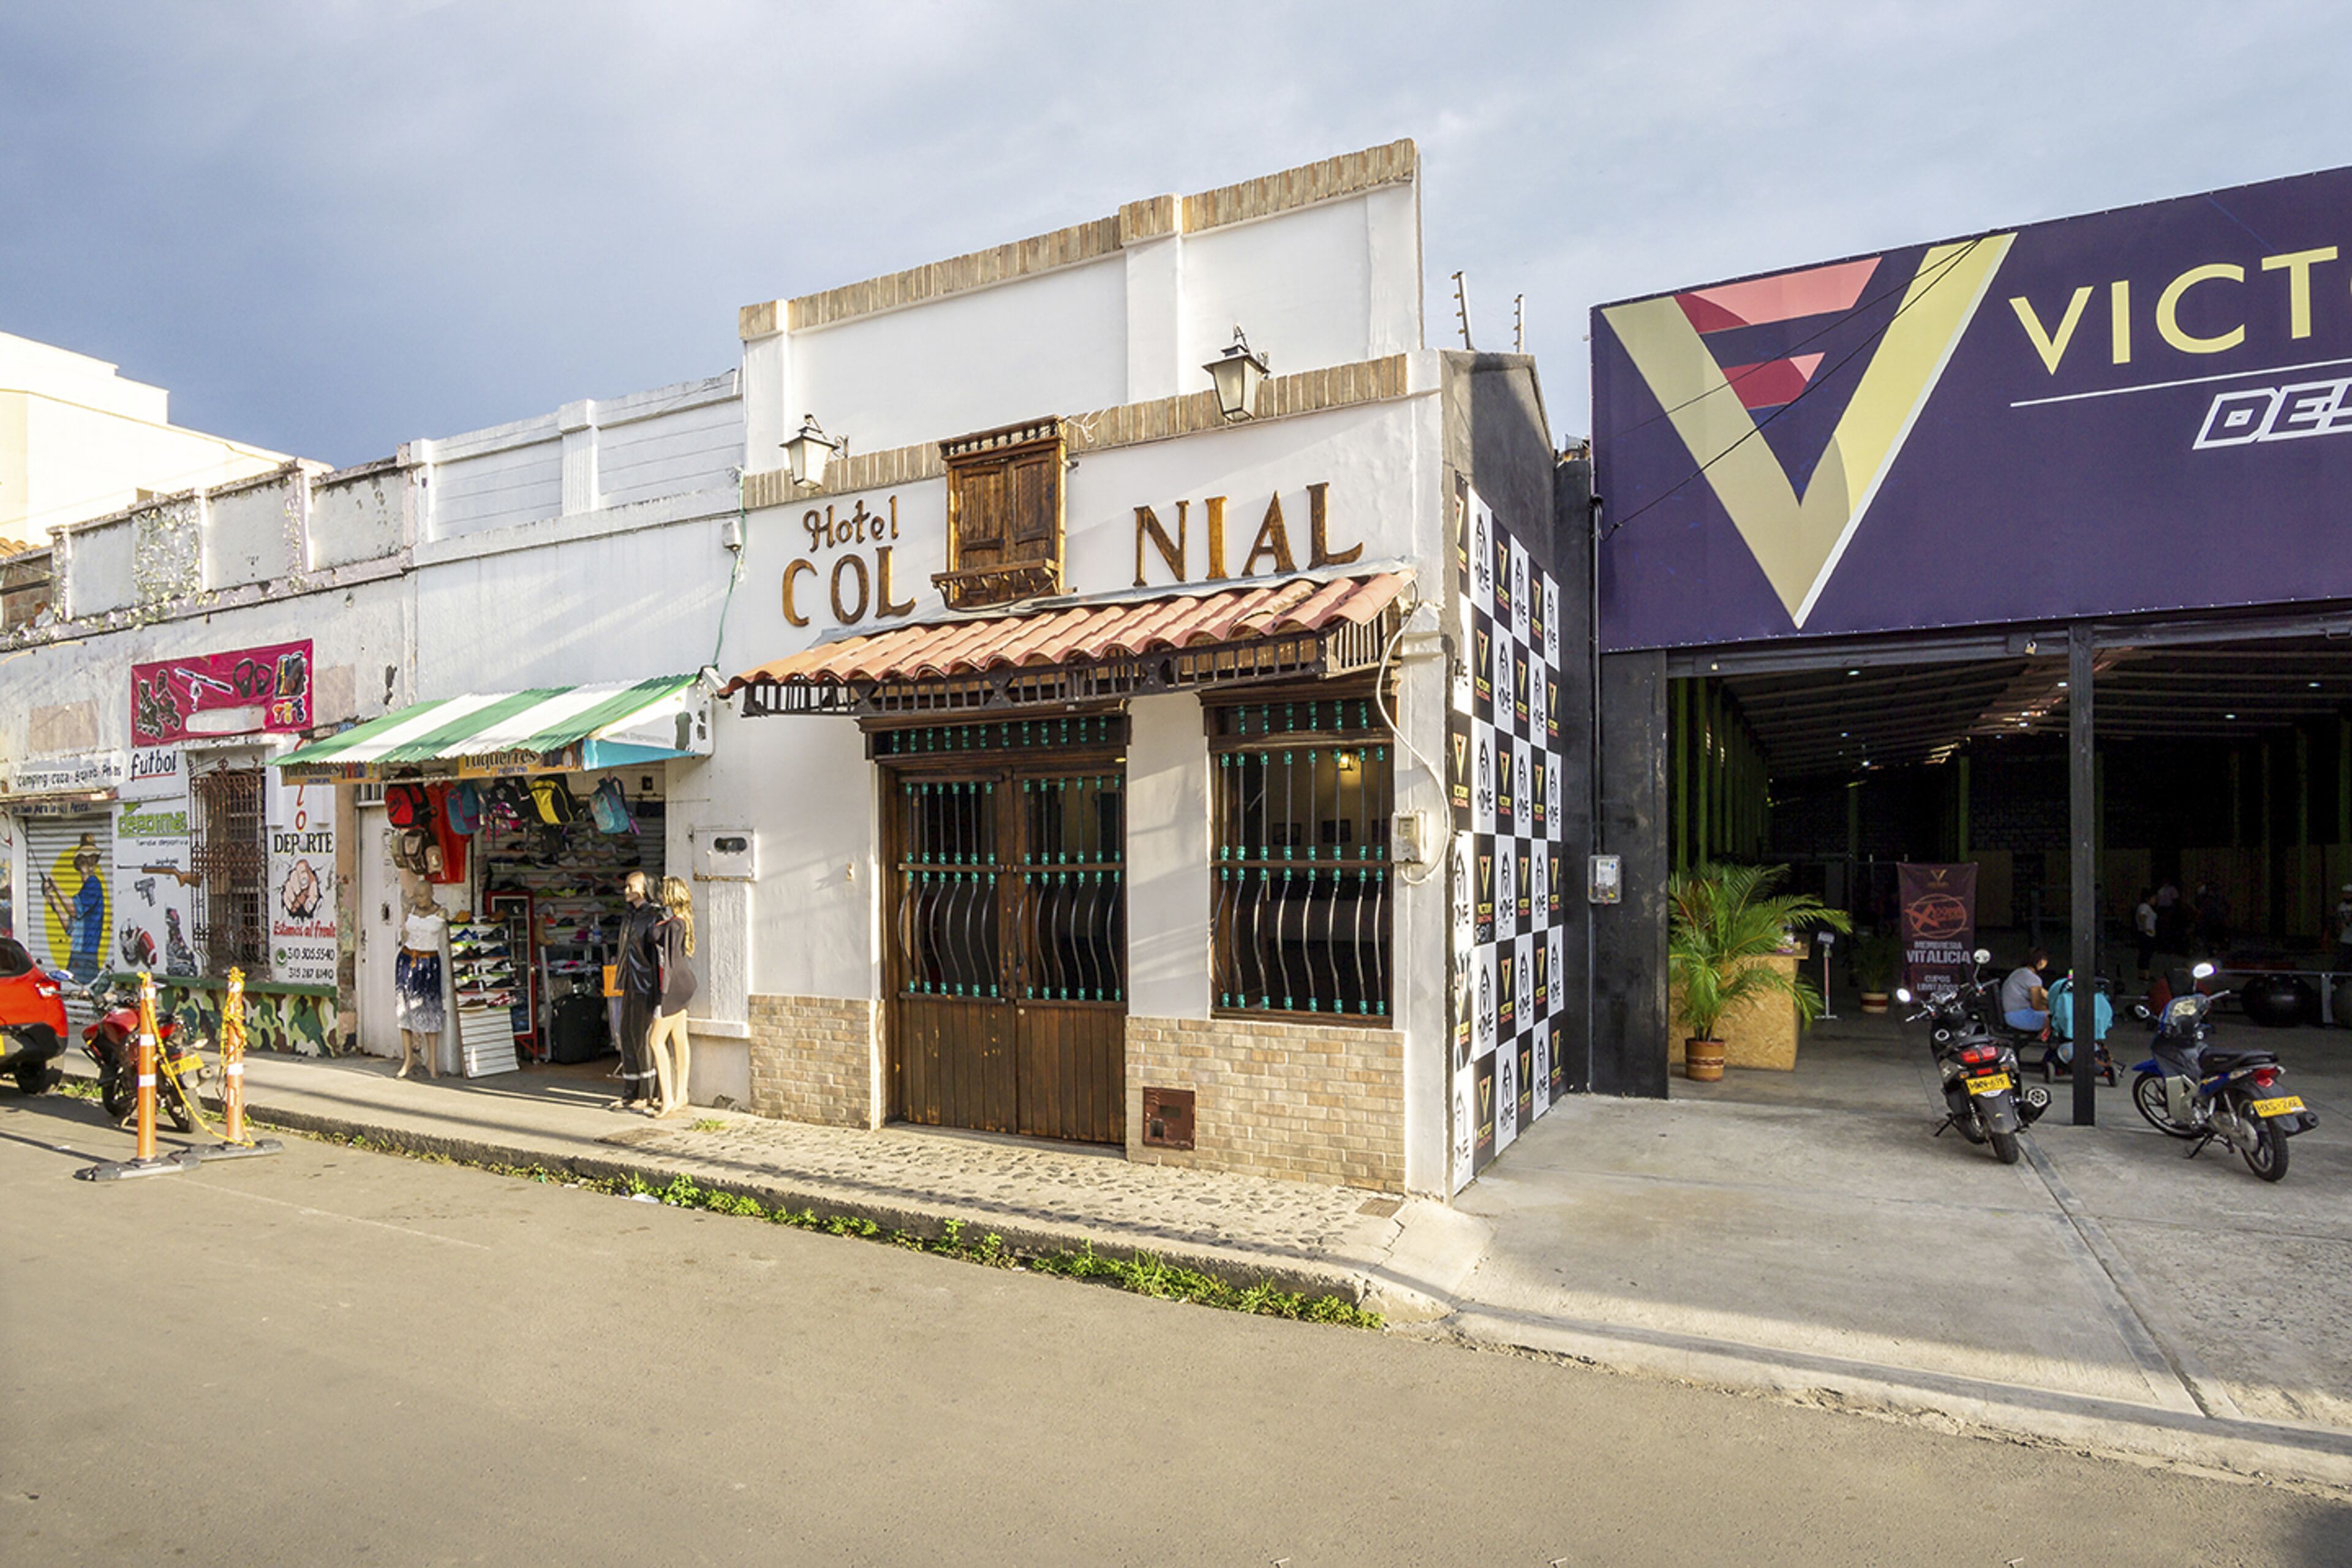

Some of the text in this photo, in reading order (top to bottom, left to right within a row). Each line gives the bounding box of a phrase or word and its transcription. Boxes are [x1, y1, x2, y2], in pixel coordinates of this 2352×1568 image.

[2008, 245, 2352, 377] VICT
[802, 494, 899, 553] Hotel
[782, 481, 1363, 627] COL NIAL
[273, 832, 334, 856] DEPORTE
[1906, 950, 1970, 964] VITALICIA
